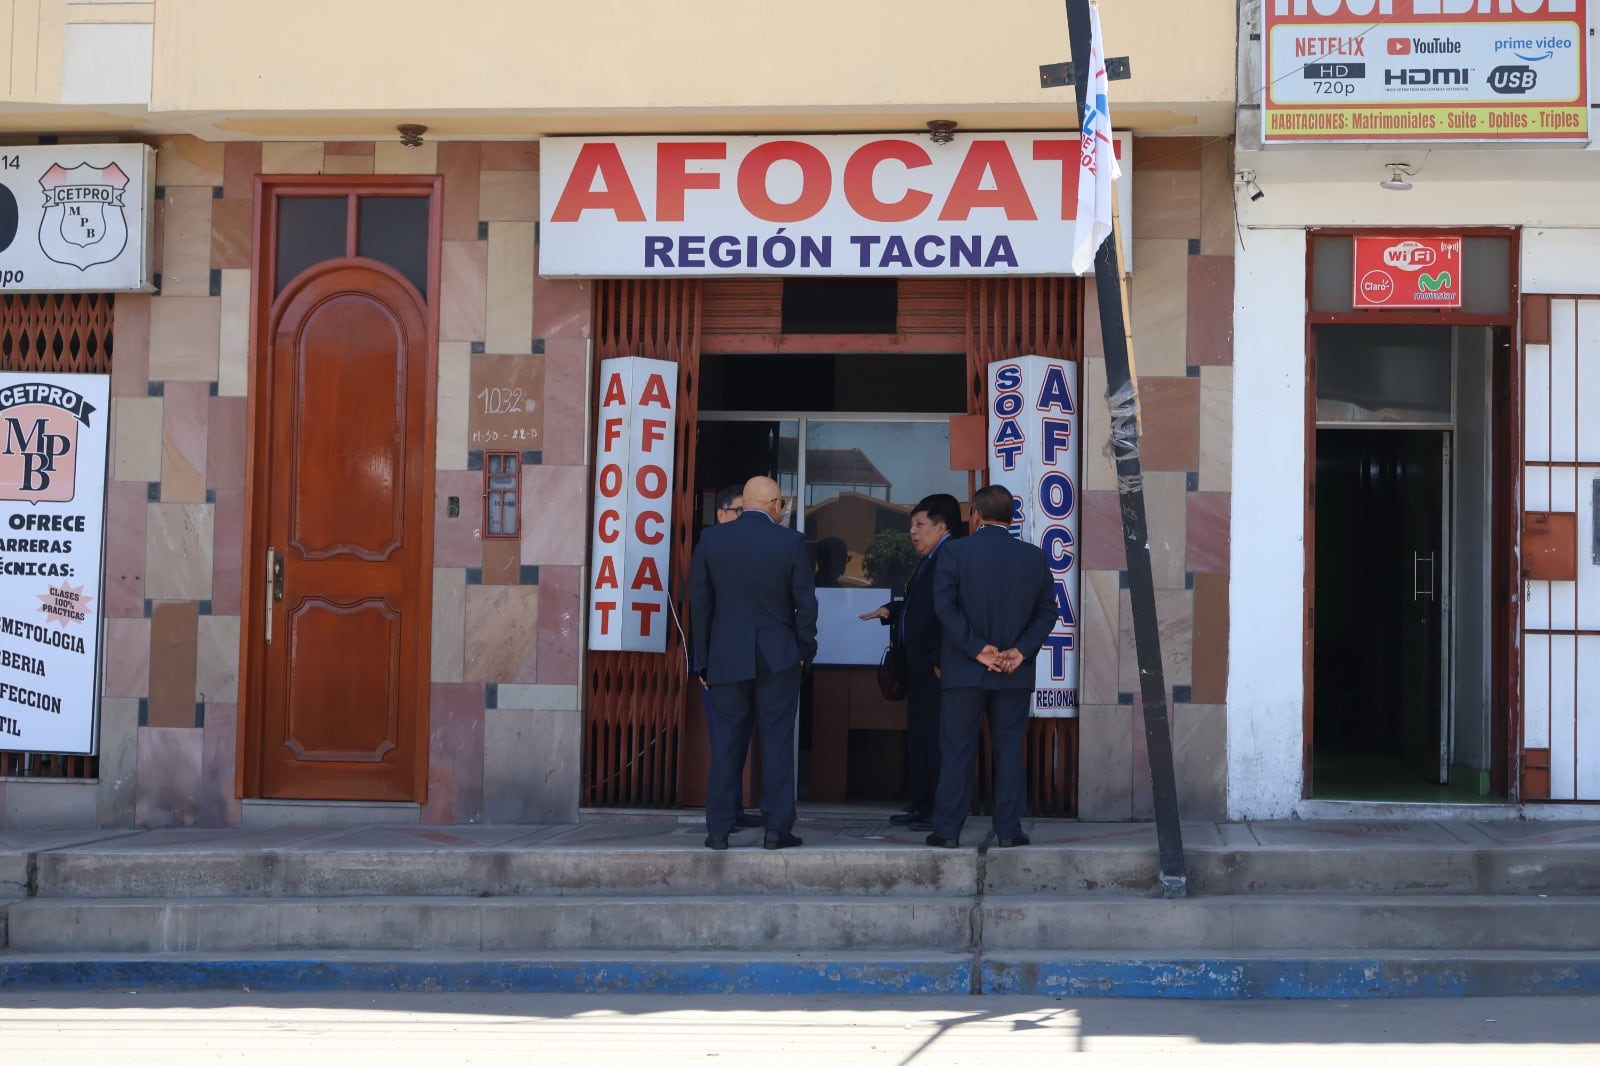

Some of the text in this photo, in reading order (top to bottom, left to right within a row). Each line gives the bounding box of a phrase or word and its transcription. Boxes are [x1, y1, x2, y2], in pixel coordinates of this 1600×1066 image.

[1296, 37, 1364, 57] NETFLIX
[1413, 37, 1461, 54] YouTube
[1495, 36, 1572, 52] prime video
[1320, 65, 1348, 78] HD
[1494, 71, 1535, 88] USB
[1313, 81, 1355, 97] 720p
[1271, 113, 1348, 130] HABITACIONES:
[1352, 112, 1436, 129] Matrimoniales
[1448, 111, 1477, 129] Suite
[1489, 111, 1528, 129] Dobles
[1540, 110, 1580, 129] Triples
[1, 155, 21, 170] 14
[550, 138, 1122, 223] AFOCAT
[57, 187, 110, 201] CETPRO
[644, 227, 1019, 268] REGIÓN TACNA
[0, 269, 24, 288] po
[1364, 282, 1386, 291] Claro
[0, 385, 77, 409] CETPRO
[477, 387, 523, 415] 1032
[994, 364, 1025, 471] SOAT
[594, 373, 626, 635] AFOCAT
[630, 373, 671, 637] AFOCAT
[8, 514, 86, 532] OFRECE
[1036, 364, 1076, 681] AFOCAT
[49, 587, 80, 602] CLASES
[54, 598, 75, 610] 100%
[42, 603, 85, 621] PRACTICAS
[0, 617, 85, 654] METOLOGIA
[0, 650, 46, 677] BERIA
[0, 683, 62, 714] FECCION
[1036, 688, 1079, 709] REGIONAL
